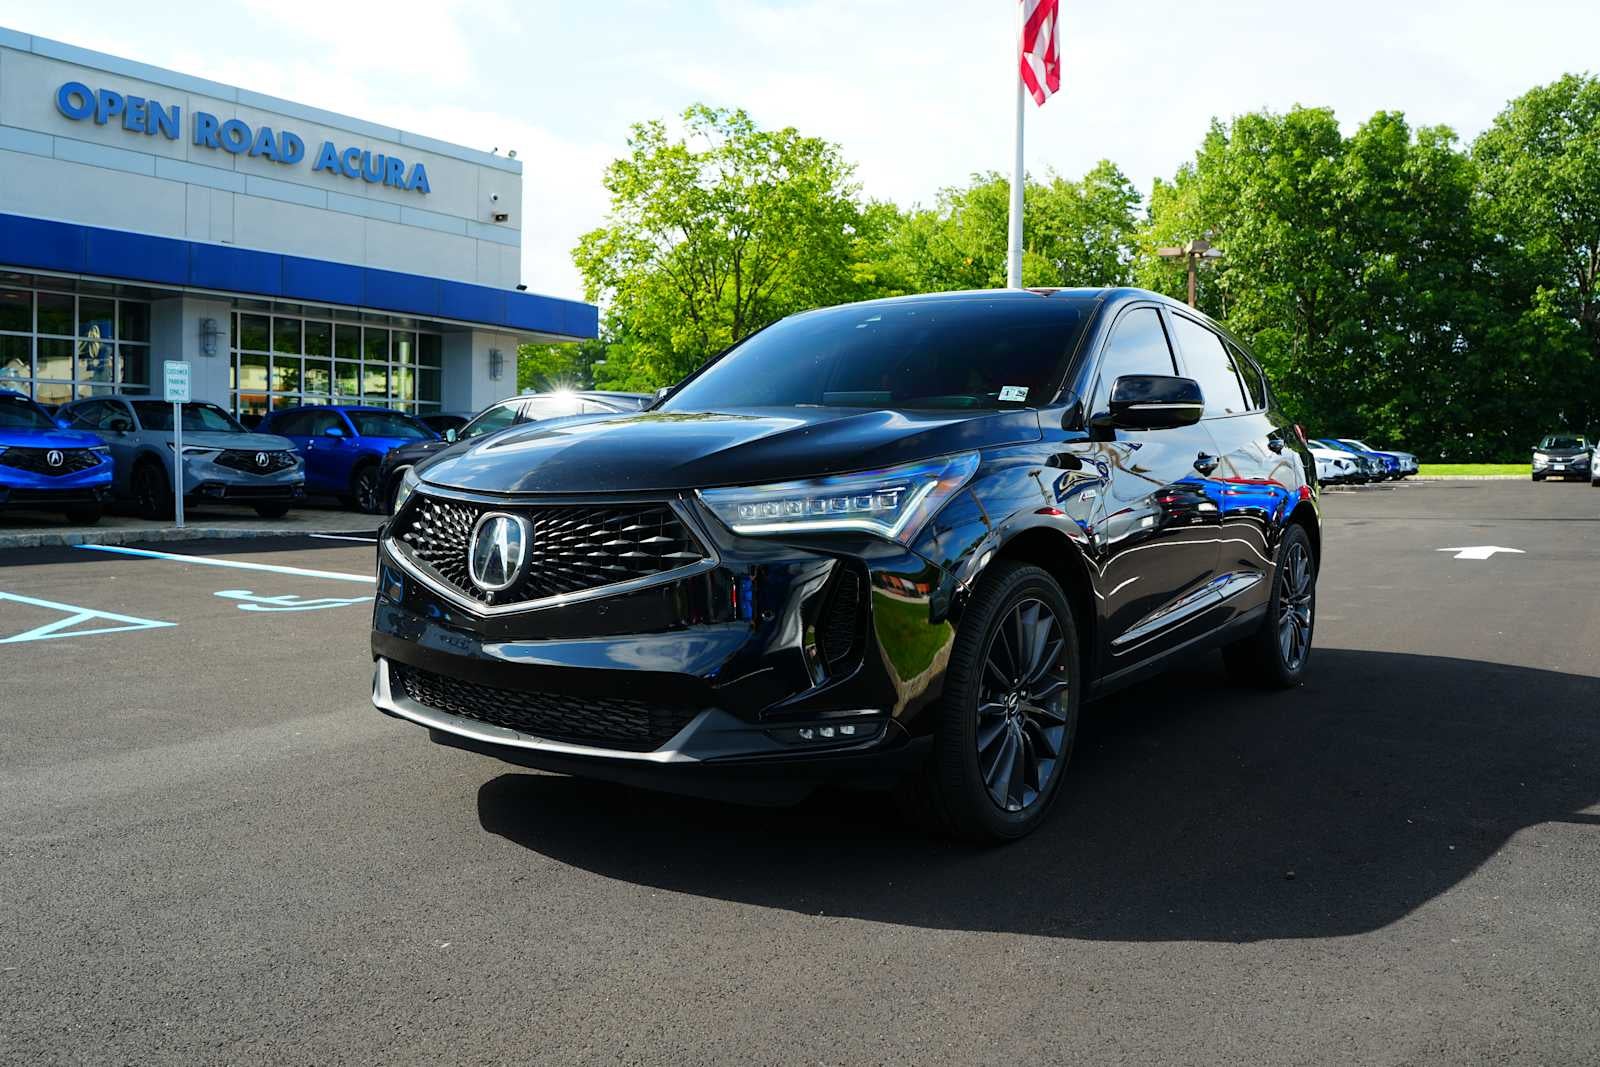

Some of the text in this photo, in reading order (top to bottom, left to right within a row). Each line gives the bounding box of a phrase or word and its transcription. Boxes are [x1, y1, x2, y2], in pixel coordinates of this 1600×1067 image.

[55, 81, 431, 194] OPEN ROAD ACURA
